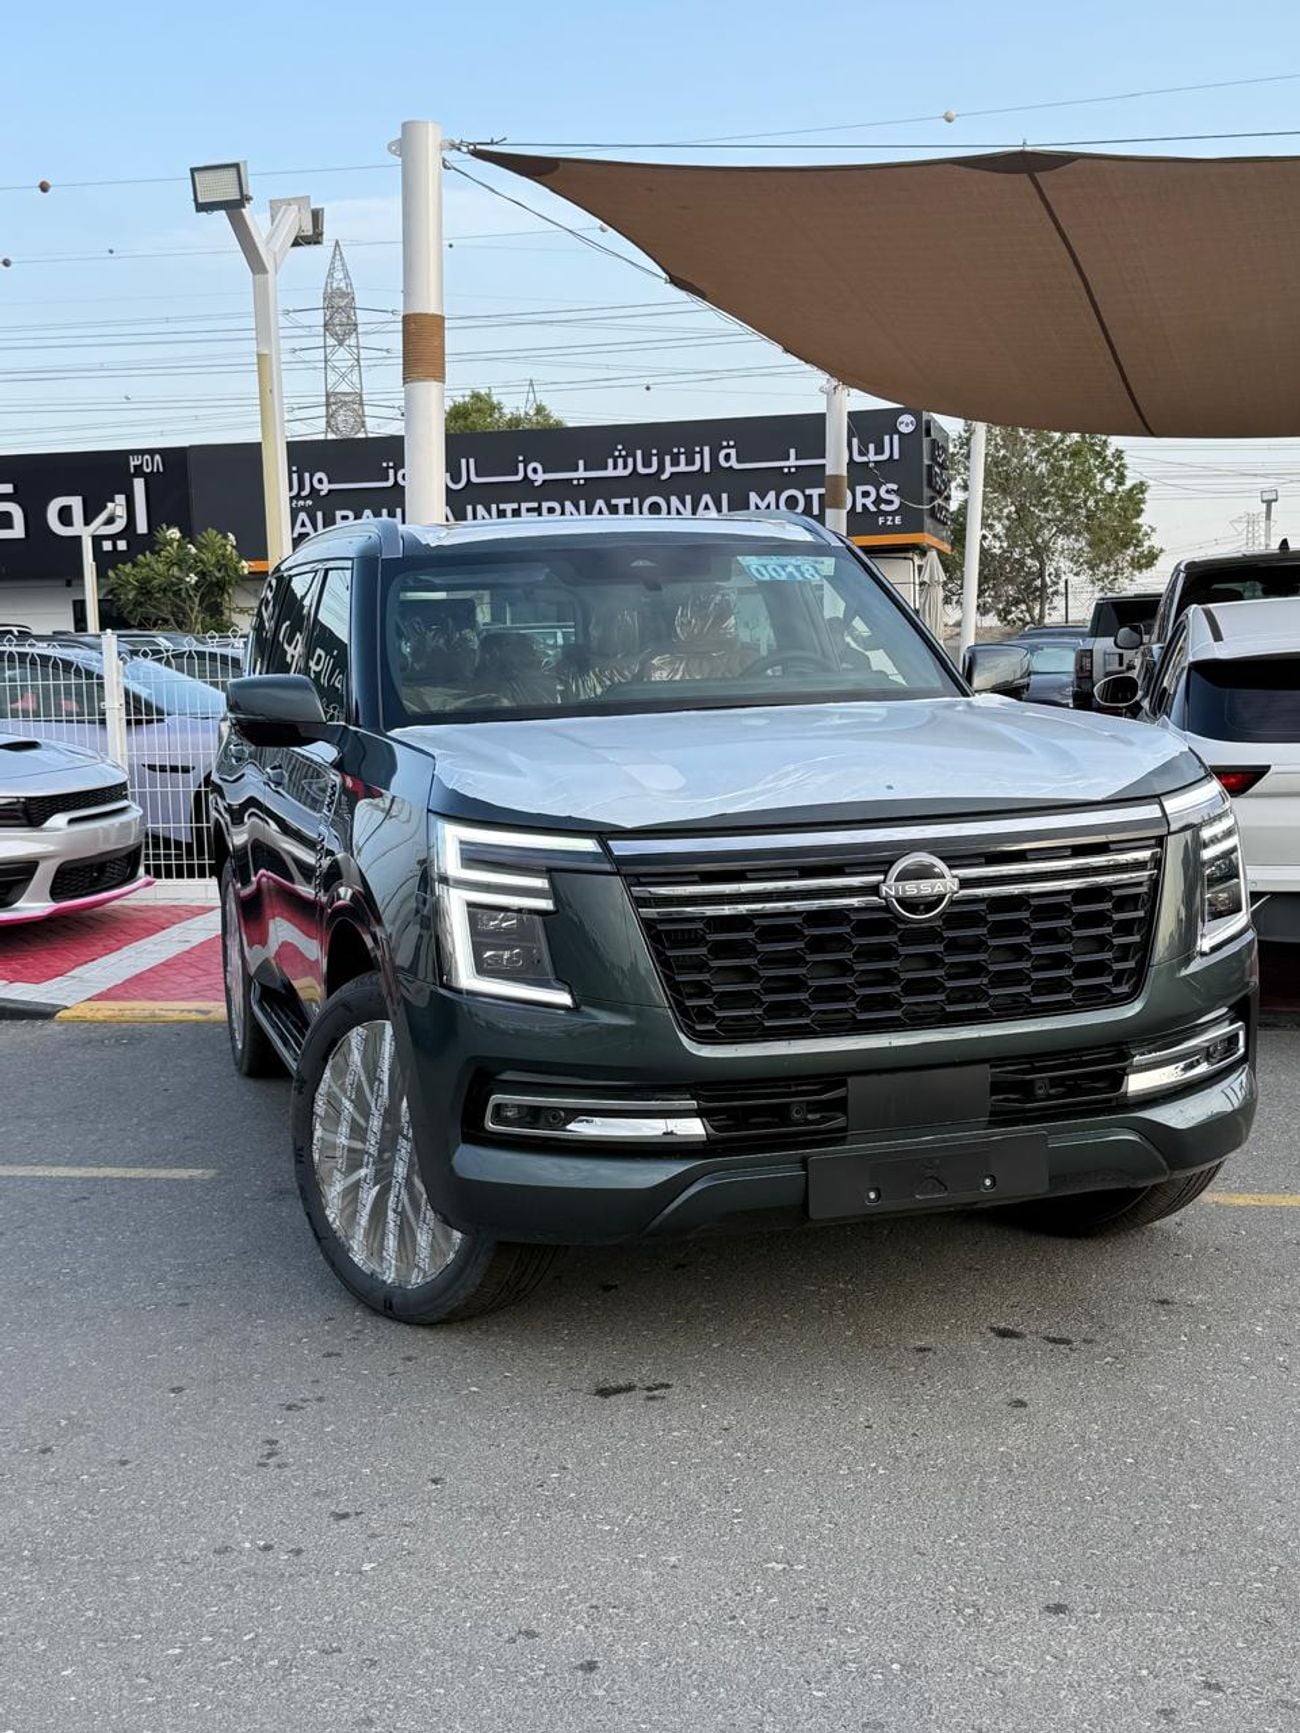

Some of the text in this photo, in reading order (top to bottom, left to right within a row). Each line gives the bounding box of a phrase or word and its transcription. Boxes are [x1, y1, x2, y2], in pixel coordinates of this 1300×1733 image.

[129, 453, 163, 474] ٣٥٨
[718, 434, 900, 473] الباية
[748, 483, 902, 516] MOTRS
[878, 515, 903, 526] FZE
[881, 881, 958, 897] NISSAN
